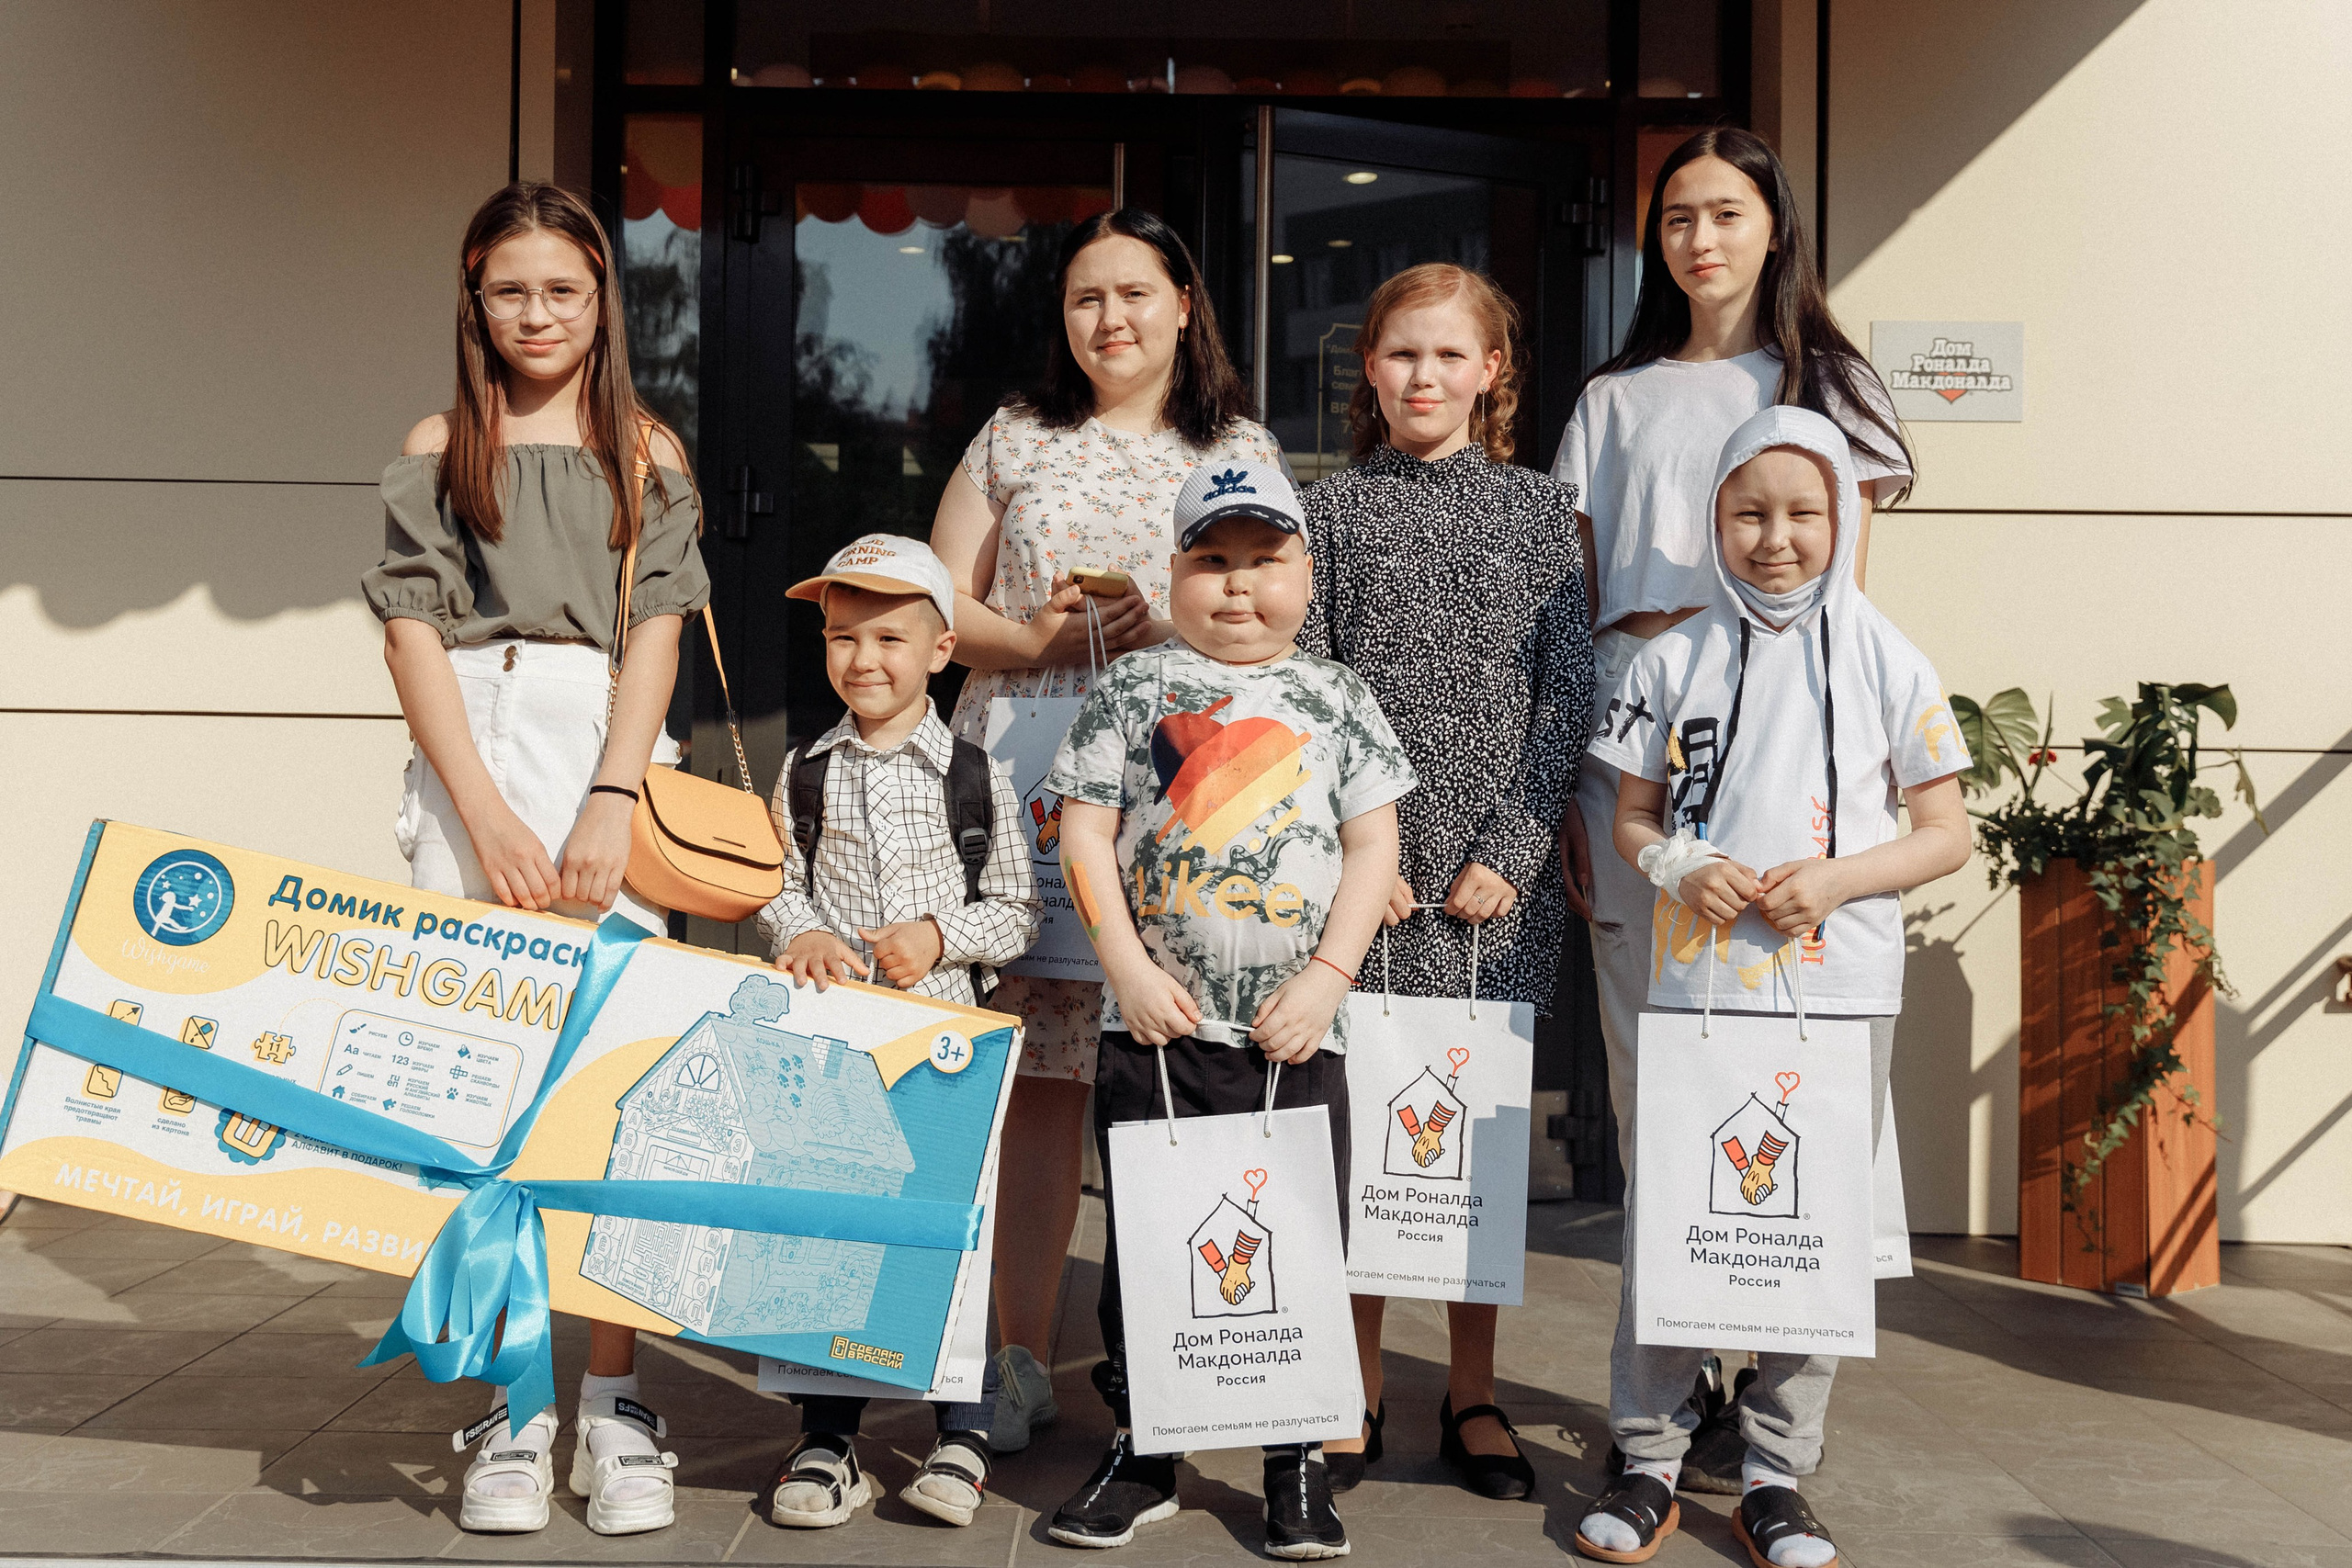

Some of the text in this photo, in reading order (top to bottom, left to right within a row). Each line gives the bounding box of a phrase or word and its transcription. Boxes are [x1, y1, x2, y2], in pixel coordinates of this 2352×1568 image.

[1931, 338, 1973, 358] Дом
[1911, 354, 1992, 373] Роналда
[1891, 371, 2012, 390] Макдоналда
[1203, 482, 1258, 502] adidas
[837, 556, 878, 568] CAMP
[268, 874, 588, 967] Домик раскраск
[122, 937, 211, 974] Wishgame
[1048, 955, 1099, 966] разлучаться
[265, 919, 573, 1031] WISHGAM
[368, 1031, 388, 1039] РИСУЕМ
[418, 1040, 441, 1049] ИЗУЧАЕМ
[937, 1035, 965, 1062] 3+
[363, 1051, 382, 1059] ЧИТАЕМ
[391, 1054, 410, 1066] 123
[477, 1053, 500, 1062] ИЗУЧАЕМ
[412, 1061, 435, 1069] ИЗУЧАЕМ
[387, 1079, 399, 1088] en
[390, 1074, 401, 1082] ru
[407, 1077, 430, 1086] ИЗУЧАЕМ
[469, 1078, 501, 1089] СКАНВОРДЫ
[471, 1074, 492, 1082] РЕШАЕМ
[350, 1091, 378, 1101] СОБИРАЕМ
[465, 1098, 492, 1108] ЖИВОТНЫХ
[466, 1093, 489, 1102] ИЗУЧАЕМ
[63, 1104, 118, 1122] предотвращают
[65, 1096, 121, 1114] Волнистые края
[401, 1102, 422, 1111] РЕШАЕМ
[75, 1114, 102, 1126] травмы
[157, 1117, 187, 1129] сделано
[161, 1125, 190, 1137] картона
[291, 1139, 403, 1171] АЛФАВИТ В ПОДАРОК!
[1361, 1184, 1483, 1209] Дом Роналда
[54, 1162, 432, 1264] МЕЧТАЙ, ИГРАЙ, РАЗВИ
[1364, 1204, 1479, 1229] Макдоналда
[1397, 1229, 1443, 1243] Россия
[1686, 1225, 1824, 1250] Дом Роналда
[1690, 1247, 1820, 1272] Макдоналда
[1346, 1269, 1506, 1289] могаем семьям не разлучаться
[1729, 1274, 1781, 1288] Россия
[1657, 1316, 1854, 1339] Помогаем семьям не разлучаться
[1173, 1326, 1303, 1352] Дом Роналда
[849, 1342, 904, 1361] СДЕЛАНО
[1178, 1348, 1302, 1370] Макдоналда
[847, 1350, 902, 1370] В РОССИИ
[1216, 1374, 1266, 1386] Россия
[1152, 1415, 1340, 1436] Помогаем семьям не разлучаться
